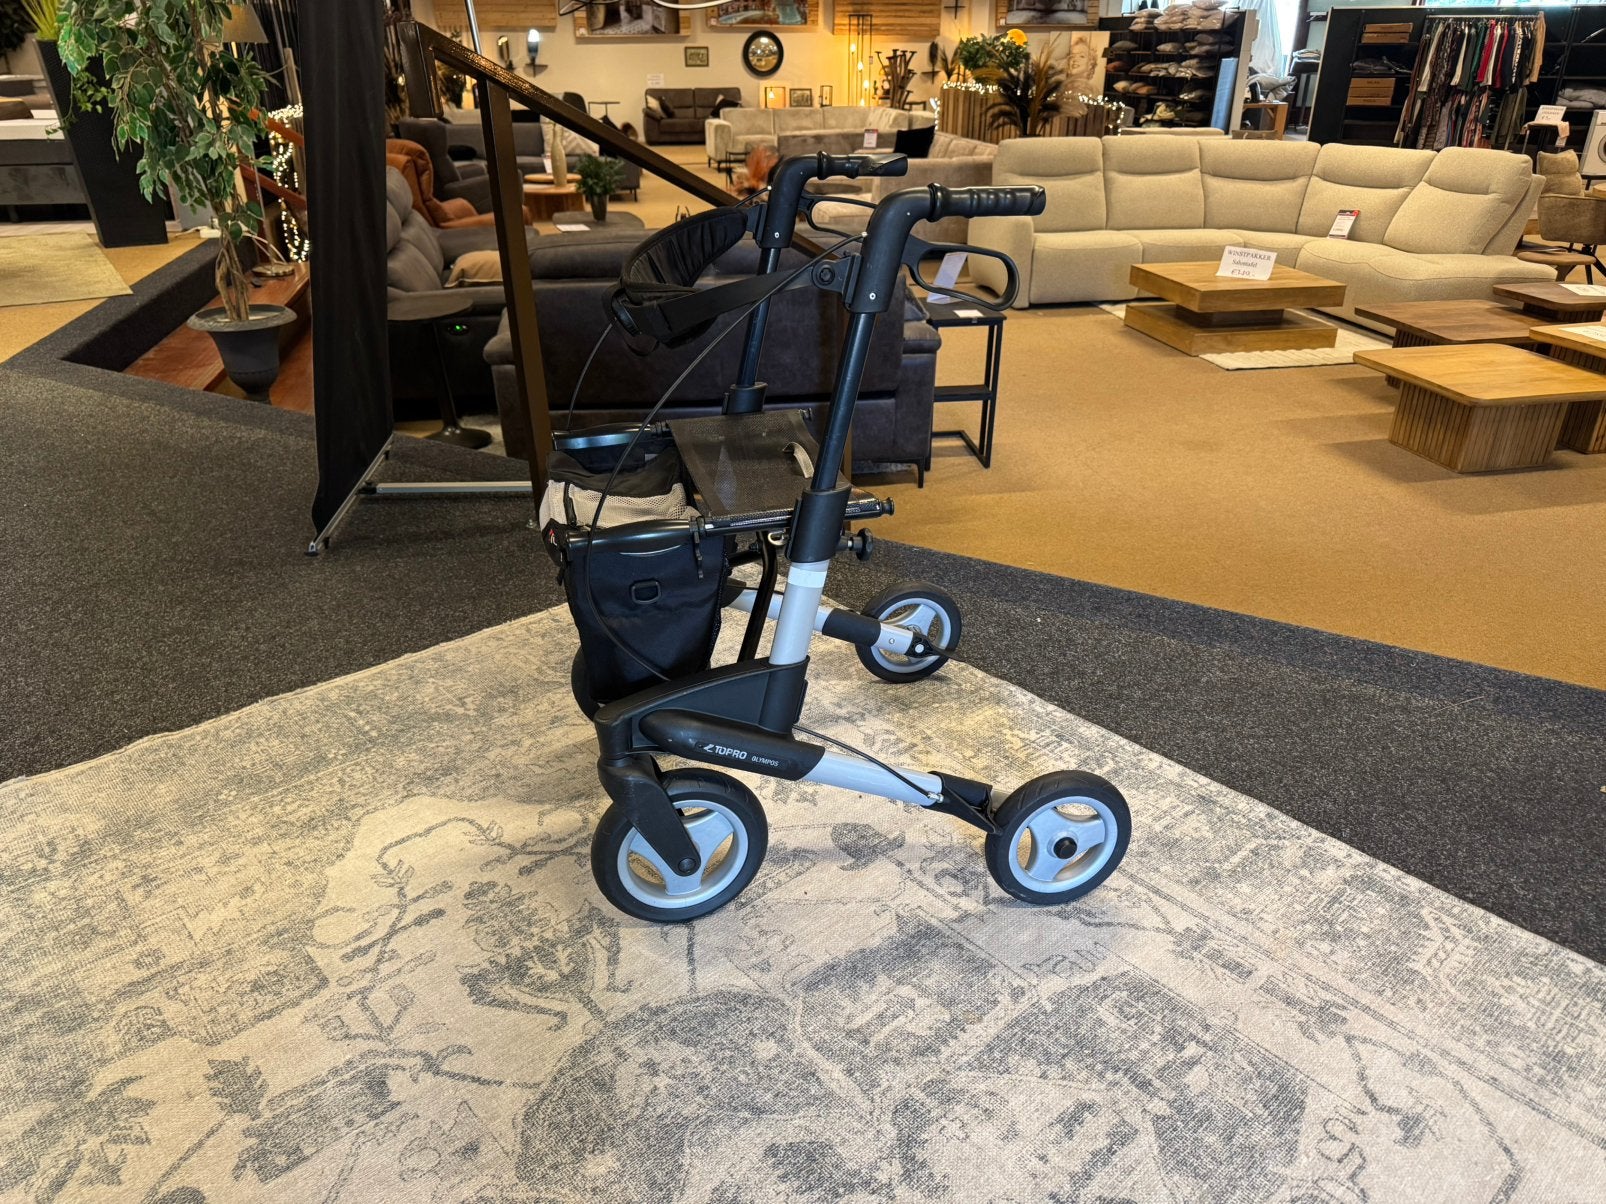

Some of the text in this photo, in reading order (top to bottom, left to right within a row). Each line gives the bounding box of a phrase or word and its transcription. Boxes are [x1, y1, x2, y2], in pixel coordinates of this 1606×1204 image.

[1228, 249, 1271, 261] WINSTPAKKER
[714, 745, 780, 767] TOPRO OLYMPOS
